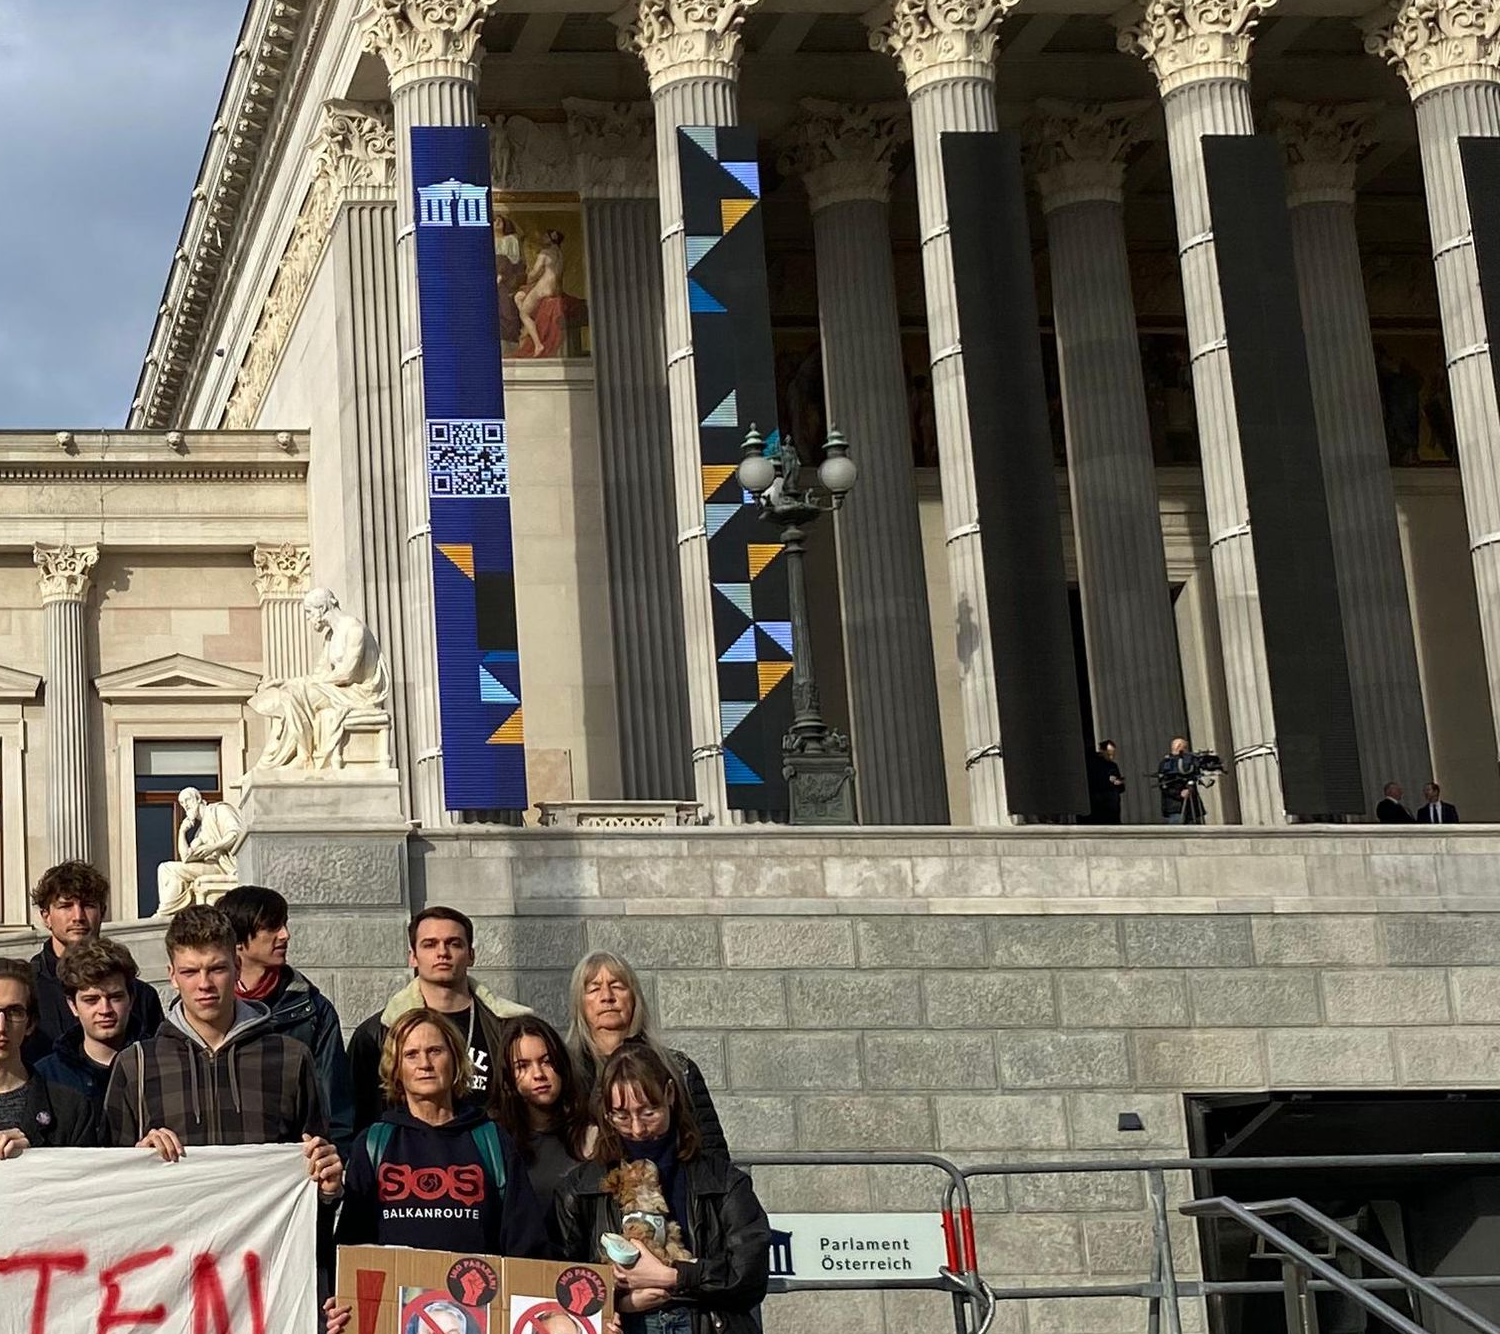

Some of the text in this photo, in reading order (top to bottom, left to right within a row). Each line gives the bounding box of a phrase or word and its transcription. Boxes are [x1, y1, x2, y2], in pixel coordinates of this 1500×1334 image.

[380, 1164, 483, 1199] SOS
[383, 1208, 479, 1219] BALKANROUTE
[820, 1237, 910, 1251] Parlament
[822, 1255, 911, 1271] Österreich
